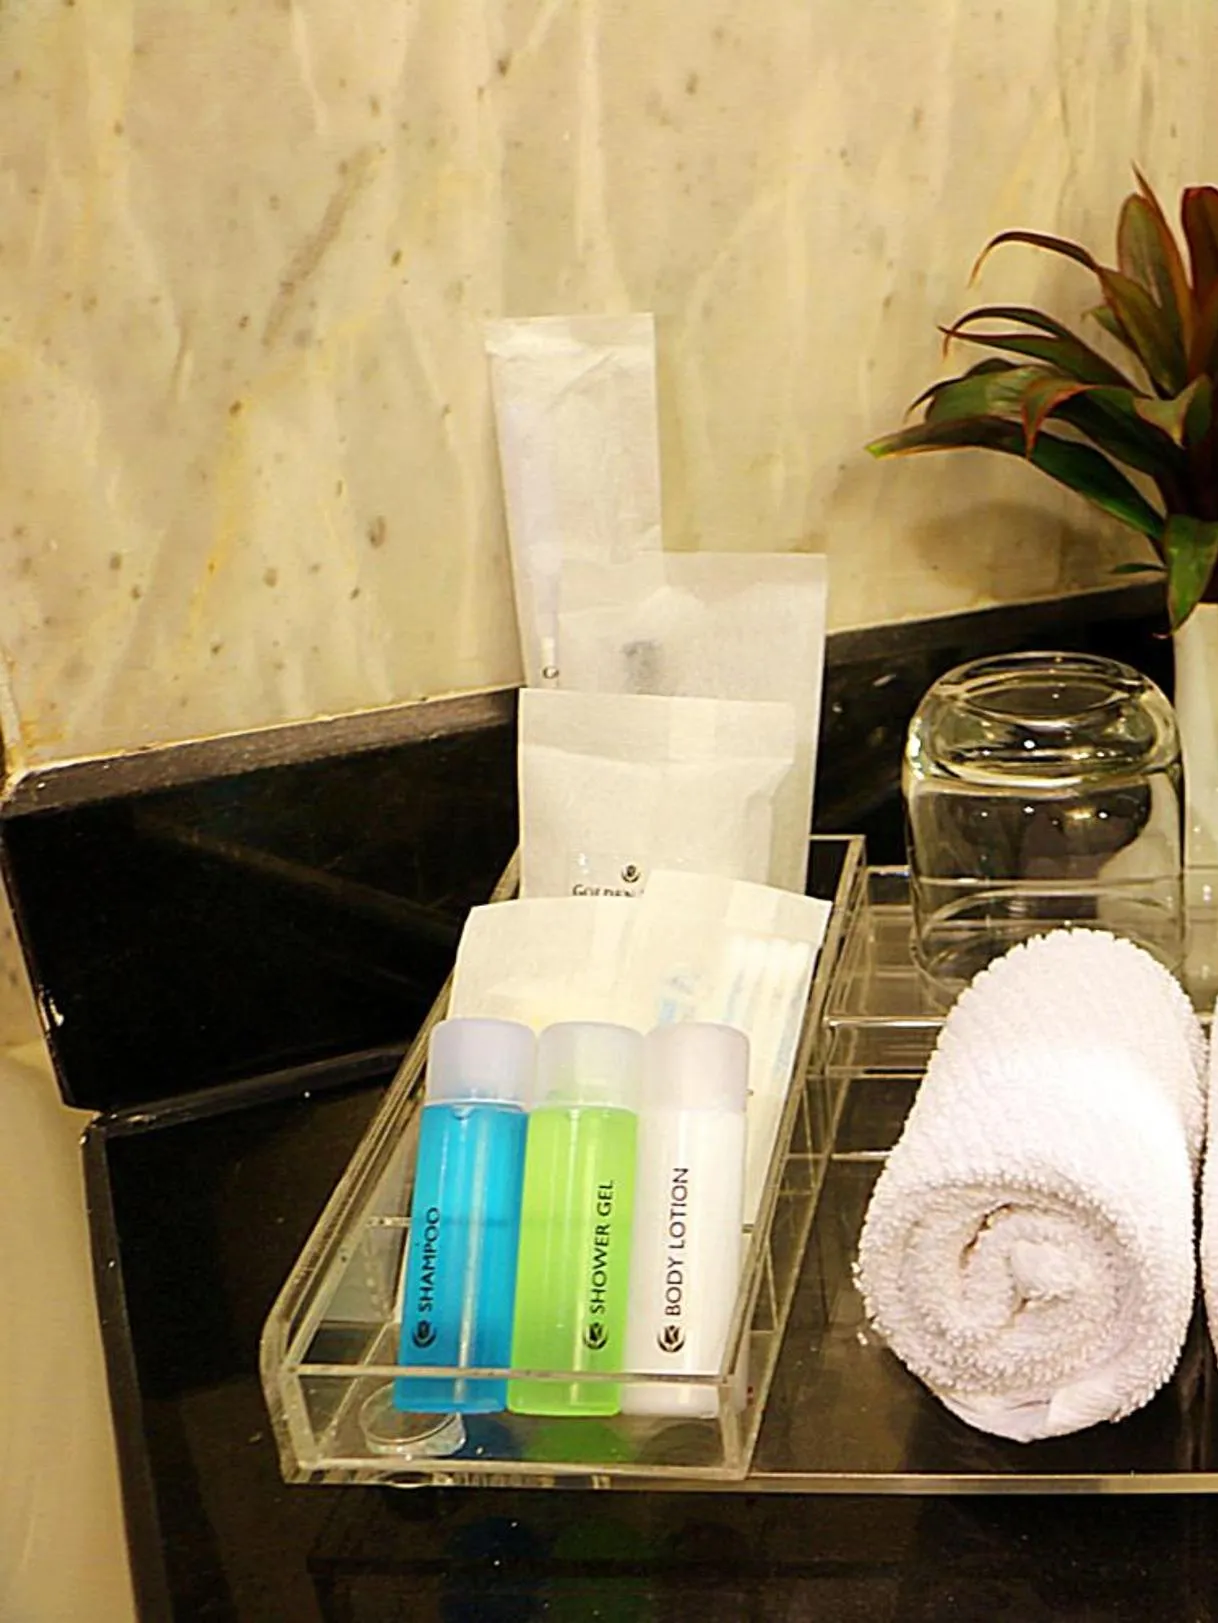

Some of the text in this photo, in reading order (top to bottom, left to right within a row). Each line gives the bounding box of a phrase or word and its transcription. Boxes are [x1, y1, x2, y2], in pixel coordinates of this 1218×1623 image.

[418, 1207, 440, 1312] SHAMPOO
[589, 1180, 614, 1315] SHOWER GEL
[664, 1167, 690, 1317] BODY LOTION
